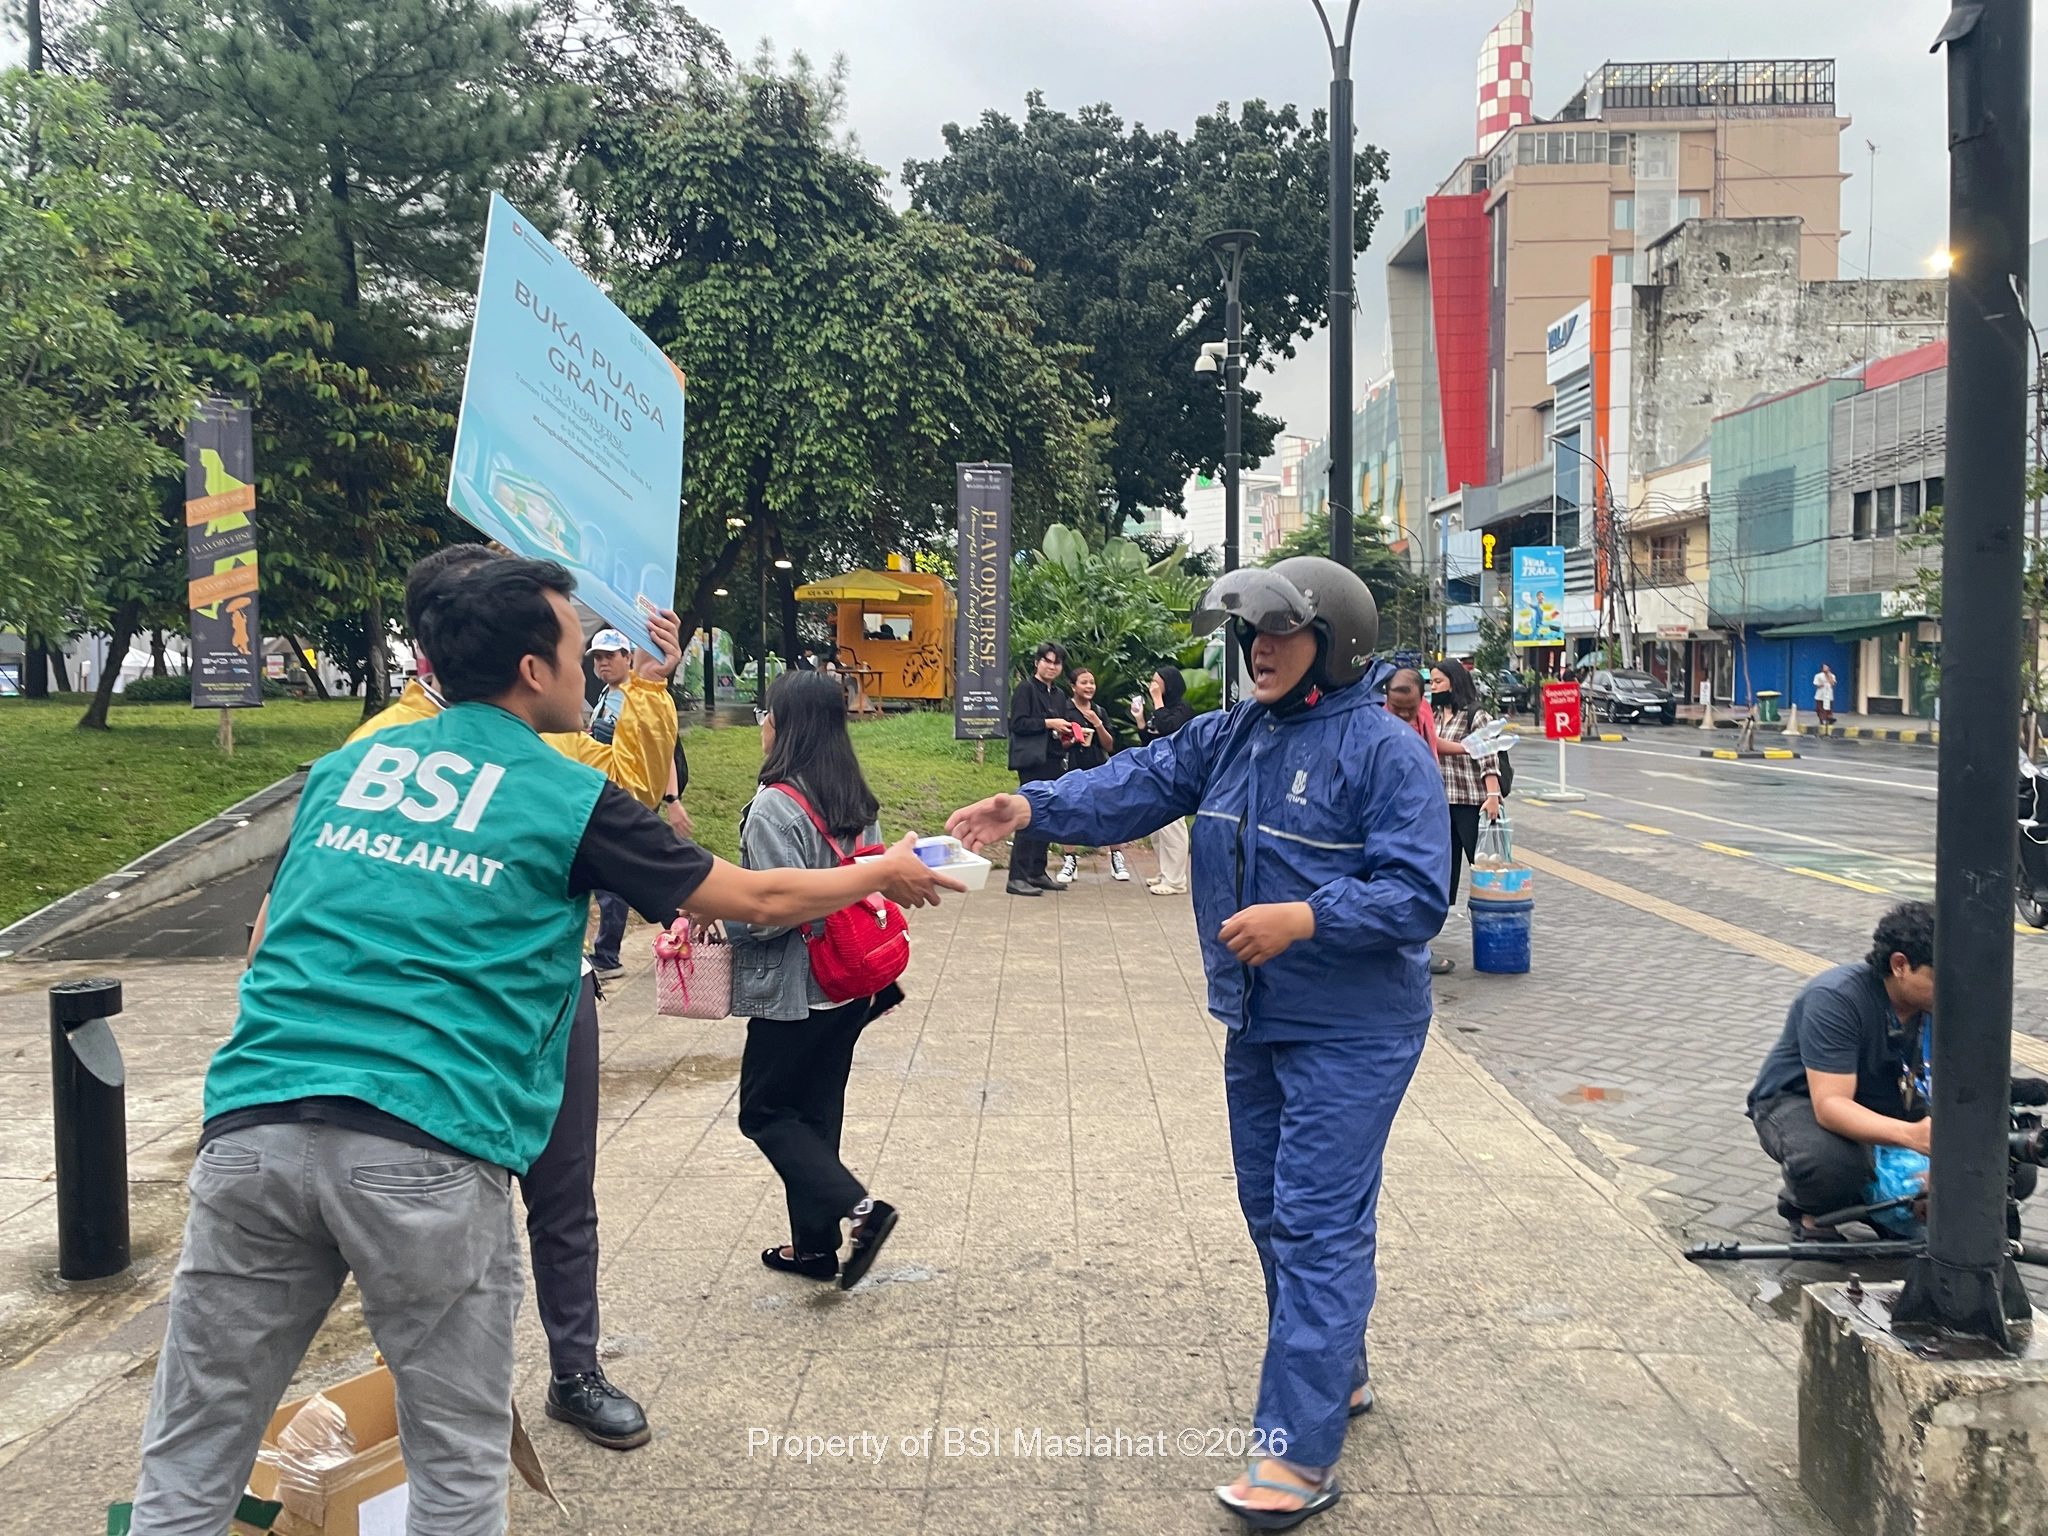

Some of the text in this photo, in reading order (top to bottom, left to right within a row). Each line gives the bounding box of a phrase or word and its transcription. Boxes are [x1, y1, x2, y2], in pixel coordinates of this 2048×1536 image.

[515, 279, 585, 359] BUKA
[592, 348, 666, 433] PUASA
[630, 332, 648, 356] BSI
[548, 347, 632, 432] GRATIS
[553, 383, 625, 452] FLAVORVERSE
[970, 562, 982, 593] and
[980, 510, 998, 668] FLAVORVERSE
[336, 743, 507, 832] BSI
[314, 822, 504, 886] MASLAHAT
